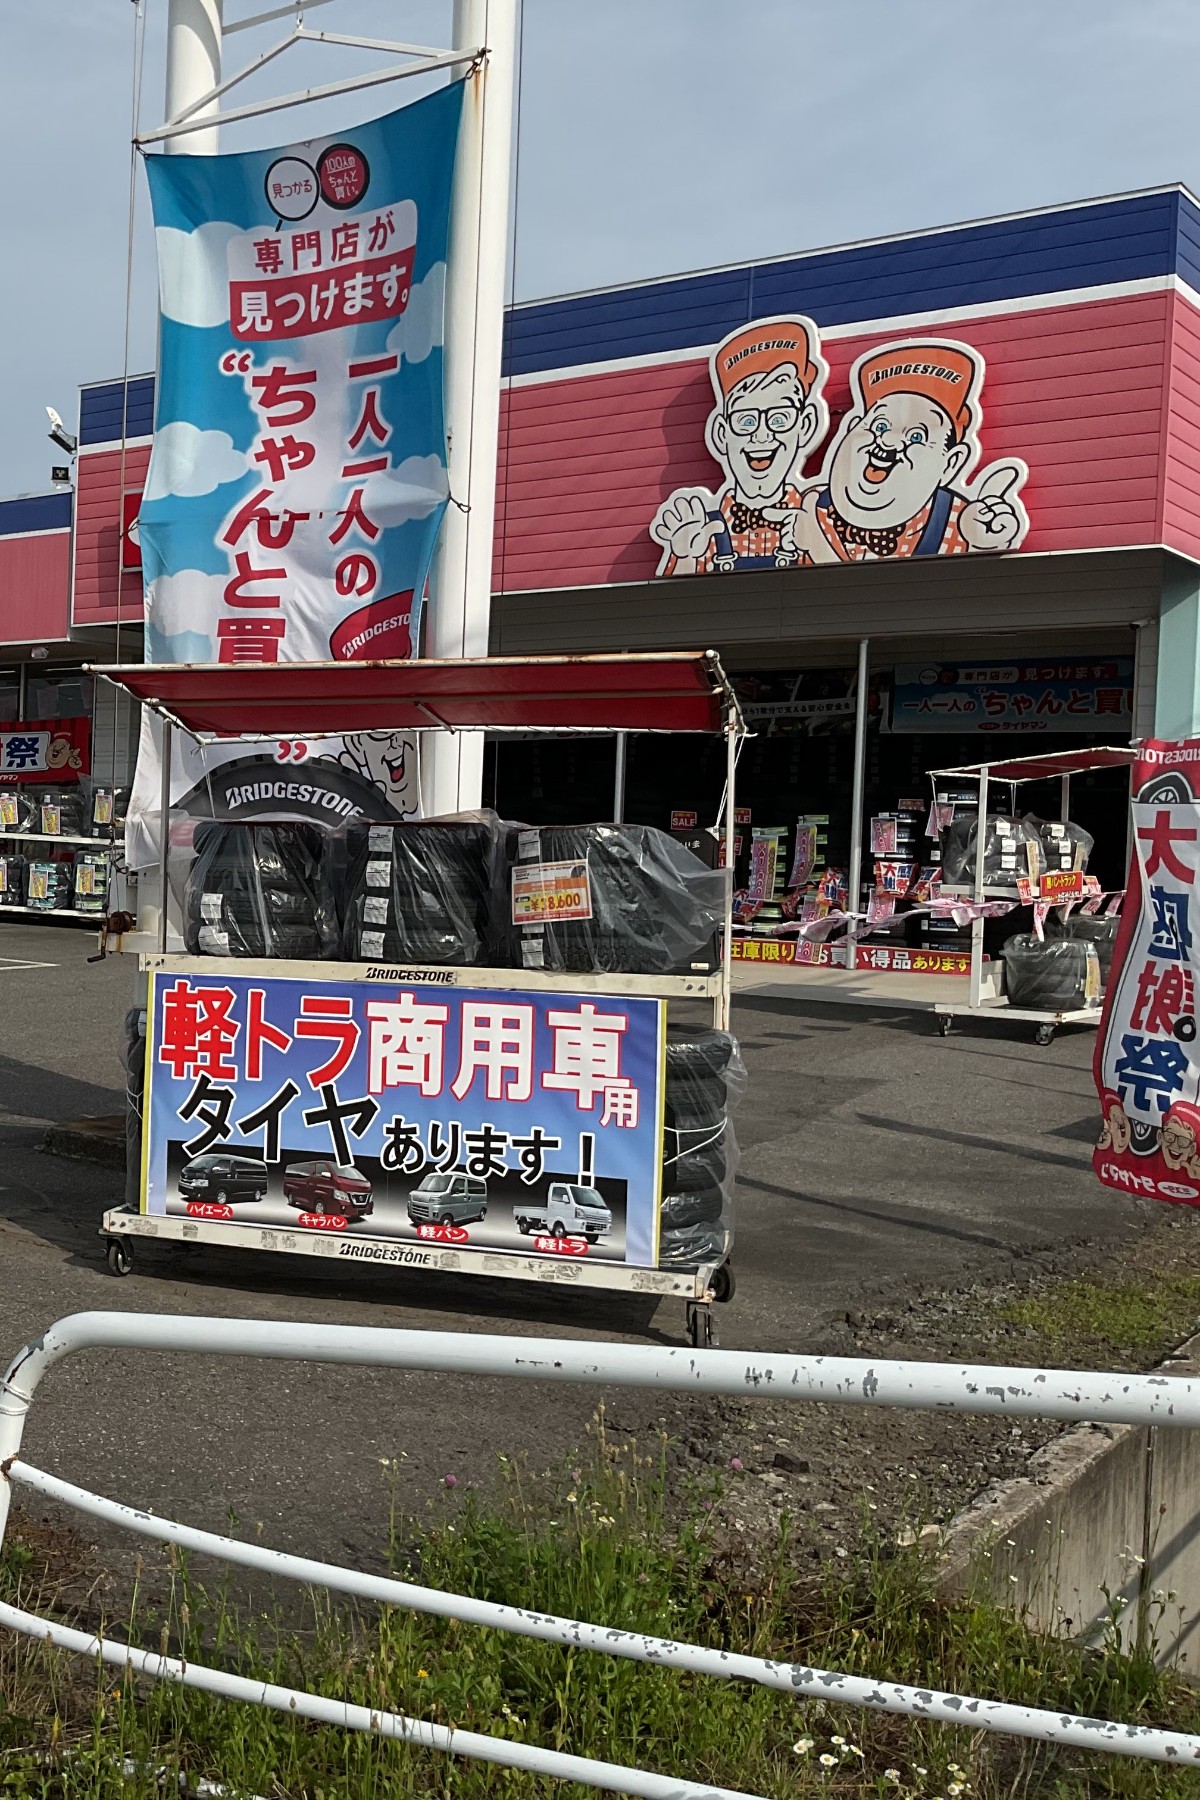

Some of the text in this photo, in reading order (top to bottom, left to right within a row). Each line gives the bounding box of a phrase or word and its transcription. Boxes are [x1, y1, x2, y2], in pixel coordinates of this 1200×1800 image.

[272, 180, 313, 199] 見つかる
[253, 210, 396, 275] 専門店が
[236, 264, 410, 334] 見つけます。
[724, 338, 799, 371] BRIDGESTONE
[868, 363, 965, 387] BRIDGESTONE
[226, 781, 365, 817] BRIDGESTONE
[672, 817, 696, 827] SALE
[365, 966, 455, 984] BRIDGESTONE
[189, 1204, 231, 1217] ハイエース
[301, 1214, 345, 1228] キャラバン
[418, 1225, 467, 1241] 軽バン
[338, 1242, 431, 1266] BRIDGESTONE
[537, 1238, 586, 1253] 軽トラ
